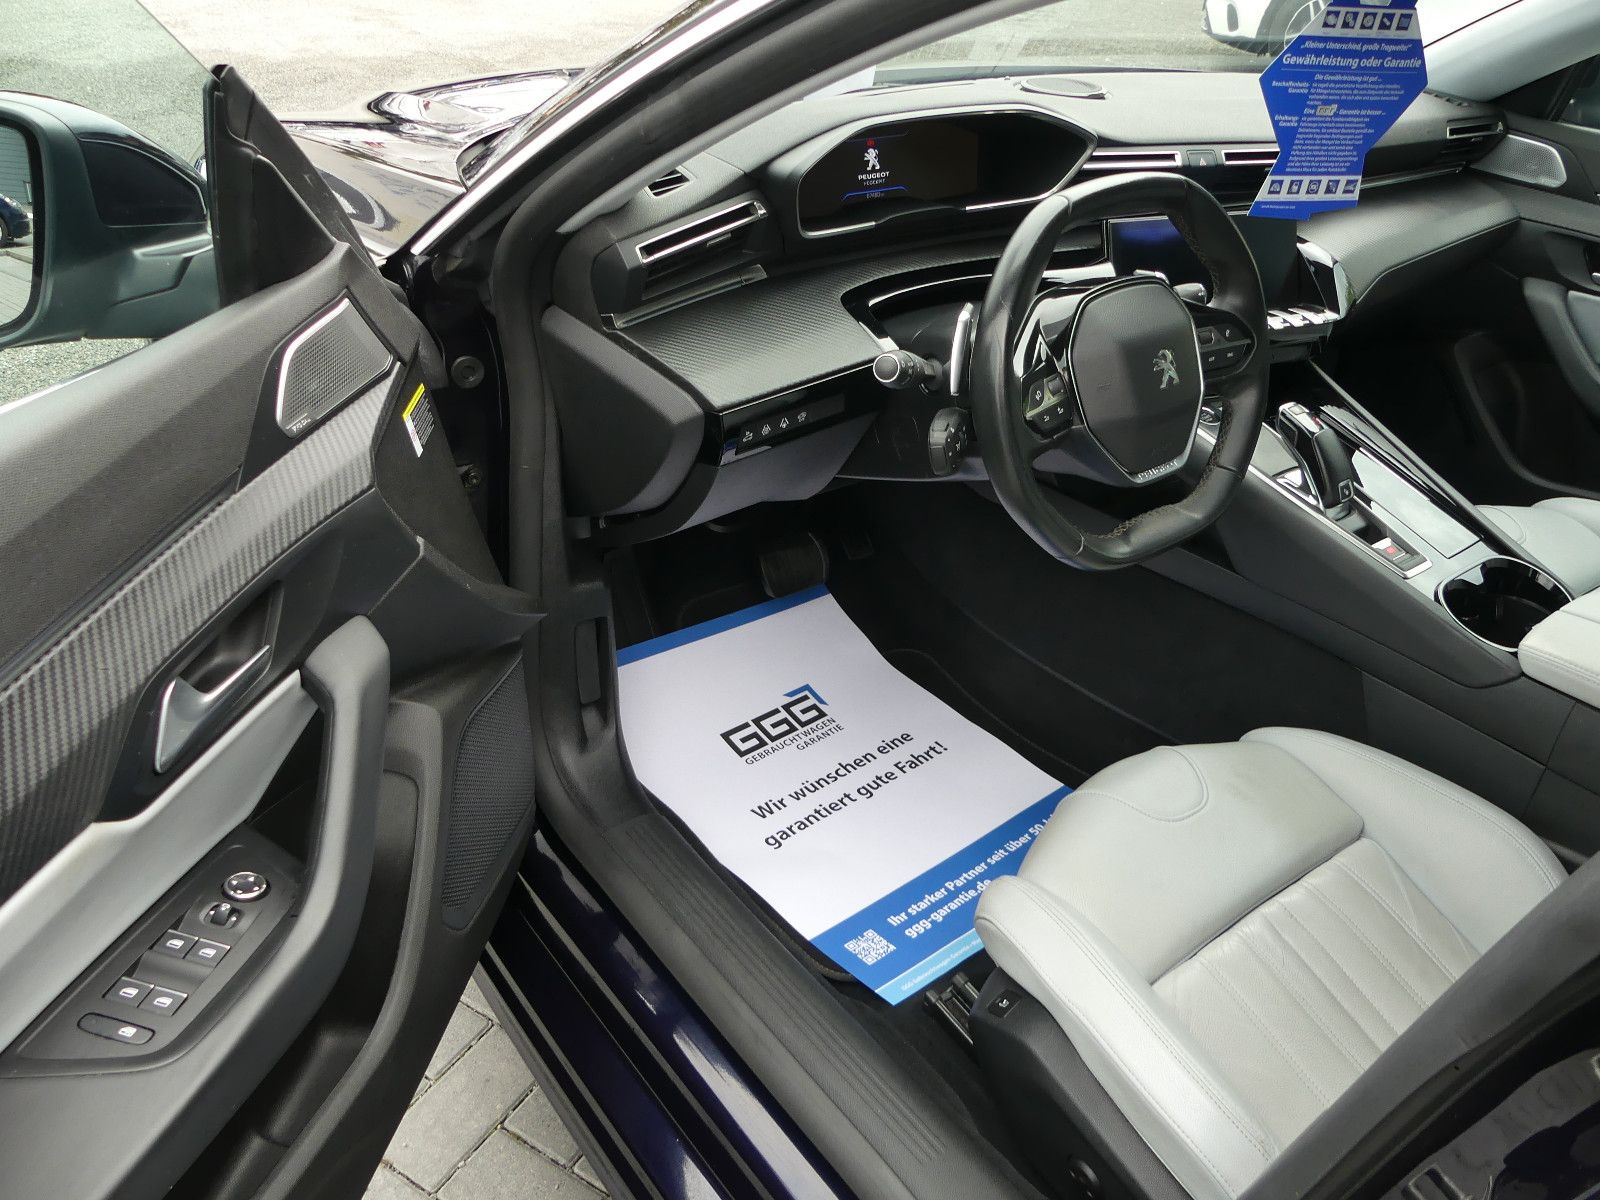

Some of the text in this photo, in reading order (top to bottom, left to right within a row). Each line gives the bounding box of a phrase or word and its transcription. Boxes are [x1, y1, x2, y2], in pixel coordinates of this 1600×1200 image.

[1283, 53, 1422, 69] Gewährleistung oder Garantie
[858, 171, 890, 181] PEUGEOT
[720, 694, 828, 758] GGG
[745, 717, 836, 765] GEBRAUCHTWAGEN
[796, 724, 844, 751] GARANTIE
[750, 733, 914, 819] Wir wünschen eine
[764, 740, 949, 849] garantiert gute Fahrt!
[887, 910, 908, 926] Ihr
[907, 888, 948, 916] starker
[944, 861, 988, 891] Partner
[987, 848, 1008, 865] seit
[1004, 833, 1031, 852] über
